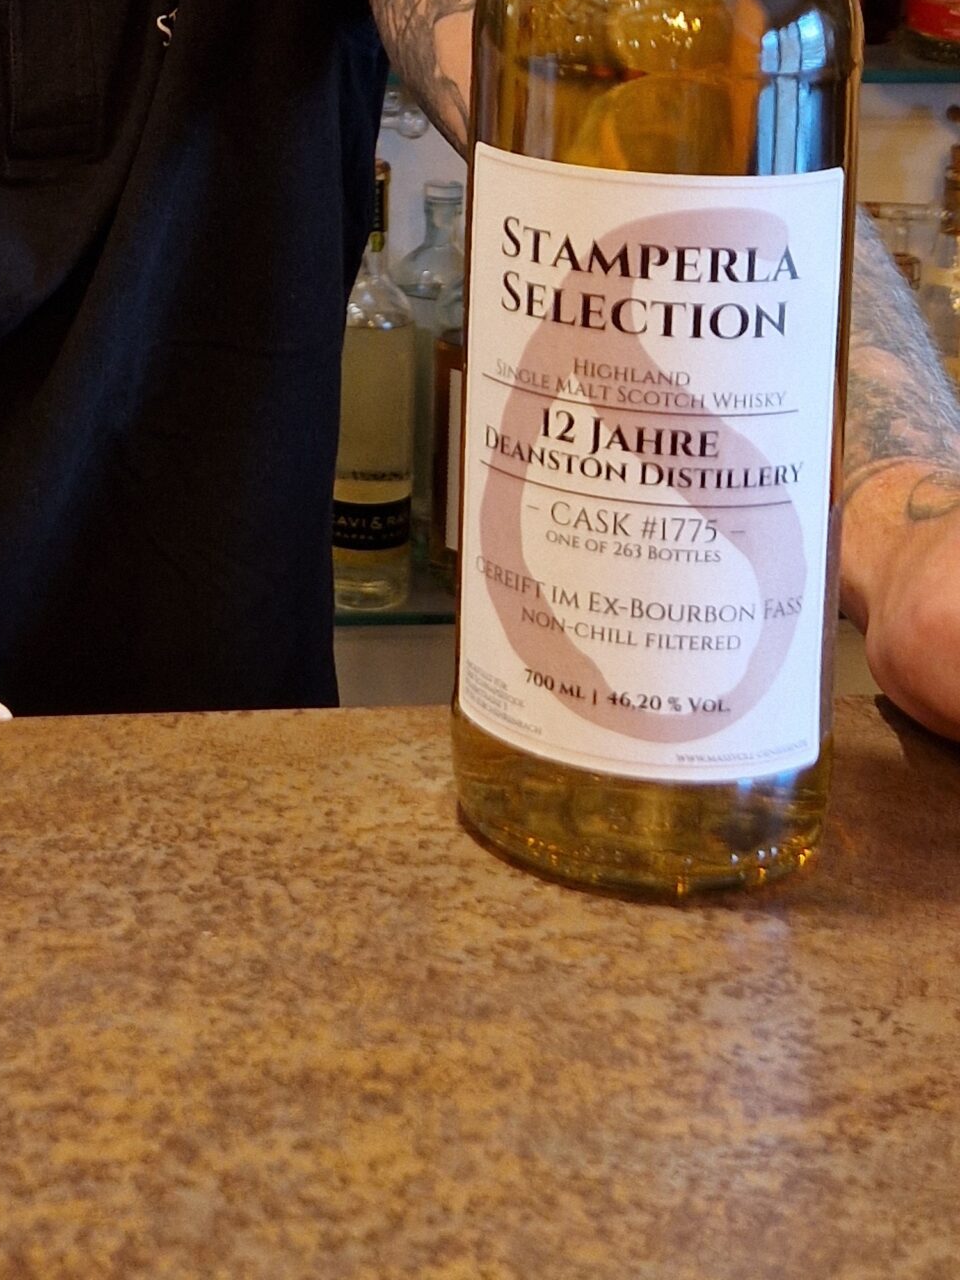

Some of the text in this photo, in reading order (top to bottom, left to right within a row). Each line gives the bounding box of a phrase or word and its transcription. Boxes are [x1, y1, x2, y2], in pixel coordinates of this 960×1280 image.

[501, 215, 800, 284] STAMPERLA
[501, 270, 787, 340] SELECTION
[555, 376, 609, 402] MALT
[617, 388, 705, 410] SCOTCH
[712, 391, 786, 410] WHISKY
[573, 357, 690, 387] HIGHLAND
[539, 407, 720, 459] 12 JAHRE
[484, 424, 804, 490] DEANSTON DISTILLERY
[550, 501, 719, 544] CASK #1775
[545, 529, 722, 564] ONE OF 263 BOTTLES
[551, 585, 580, 610] IM
[588, 591, 756, 626] EX-BOURBON
[521, 606, 742, 652] NON-CHILL FILTERED
[524, 667, 555, 693] 700
